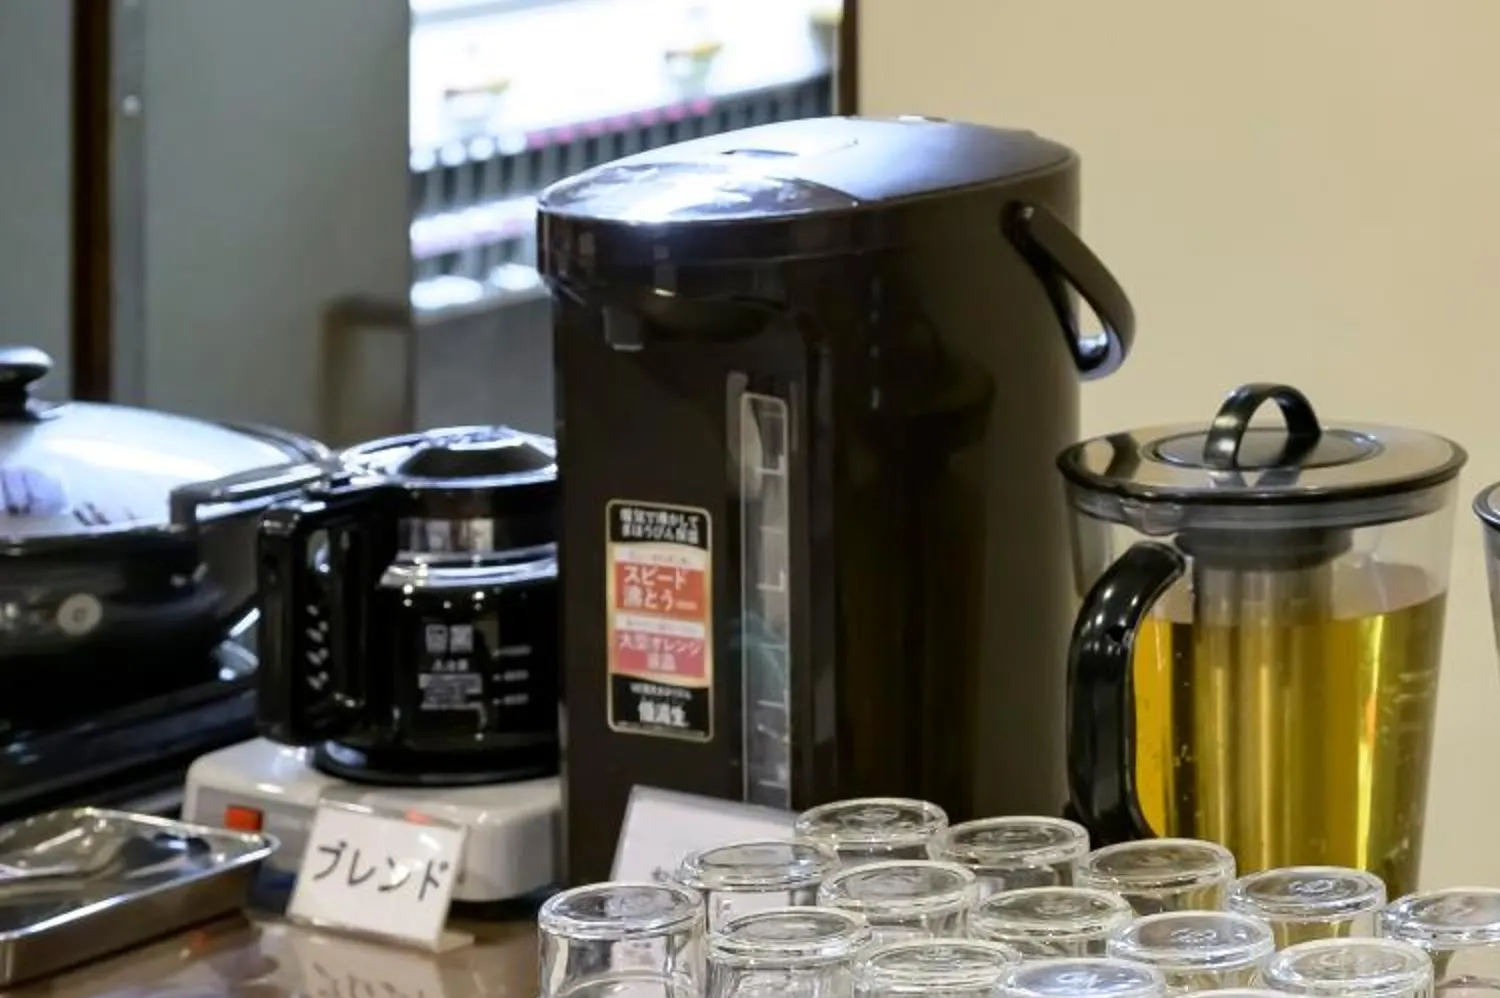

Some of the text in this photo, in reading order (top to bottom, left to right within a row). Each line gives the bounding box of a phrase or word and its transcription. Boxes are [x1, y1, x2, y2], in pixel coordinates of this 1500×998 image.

[623, 565, 688, 590] スピード
[313, 841, 449, 901] ブレンド
